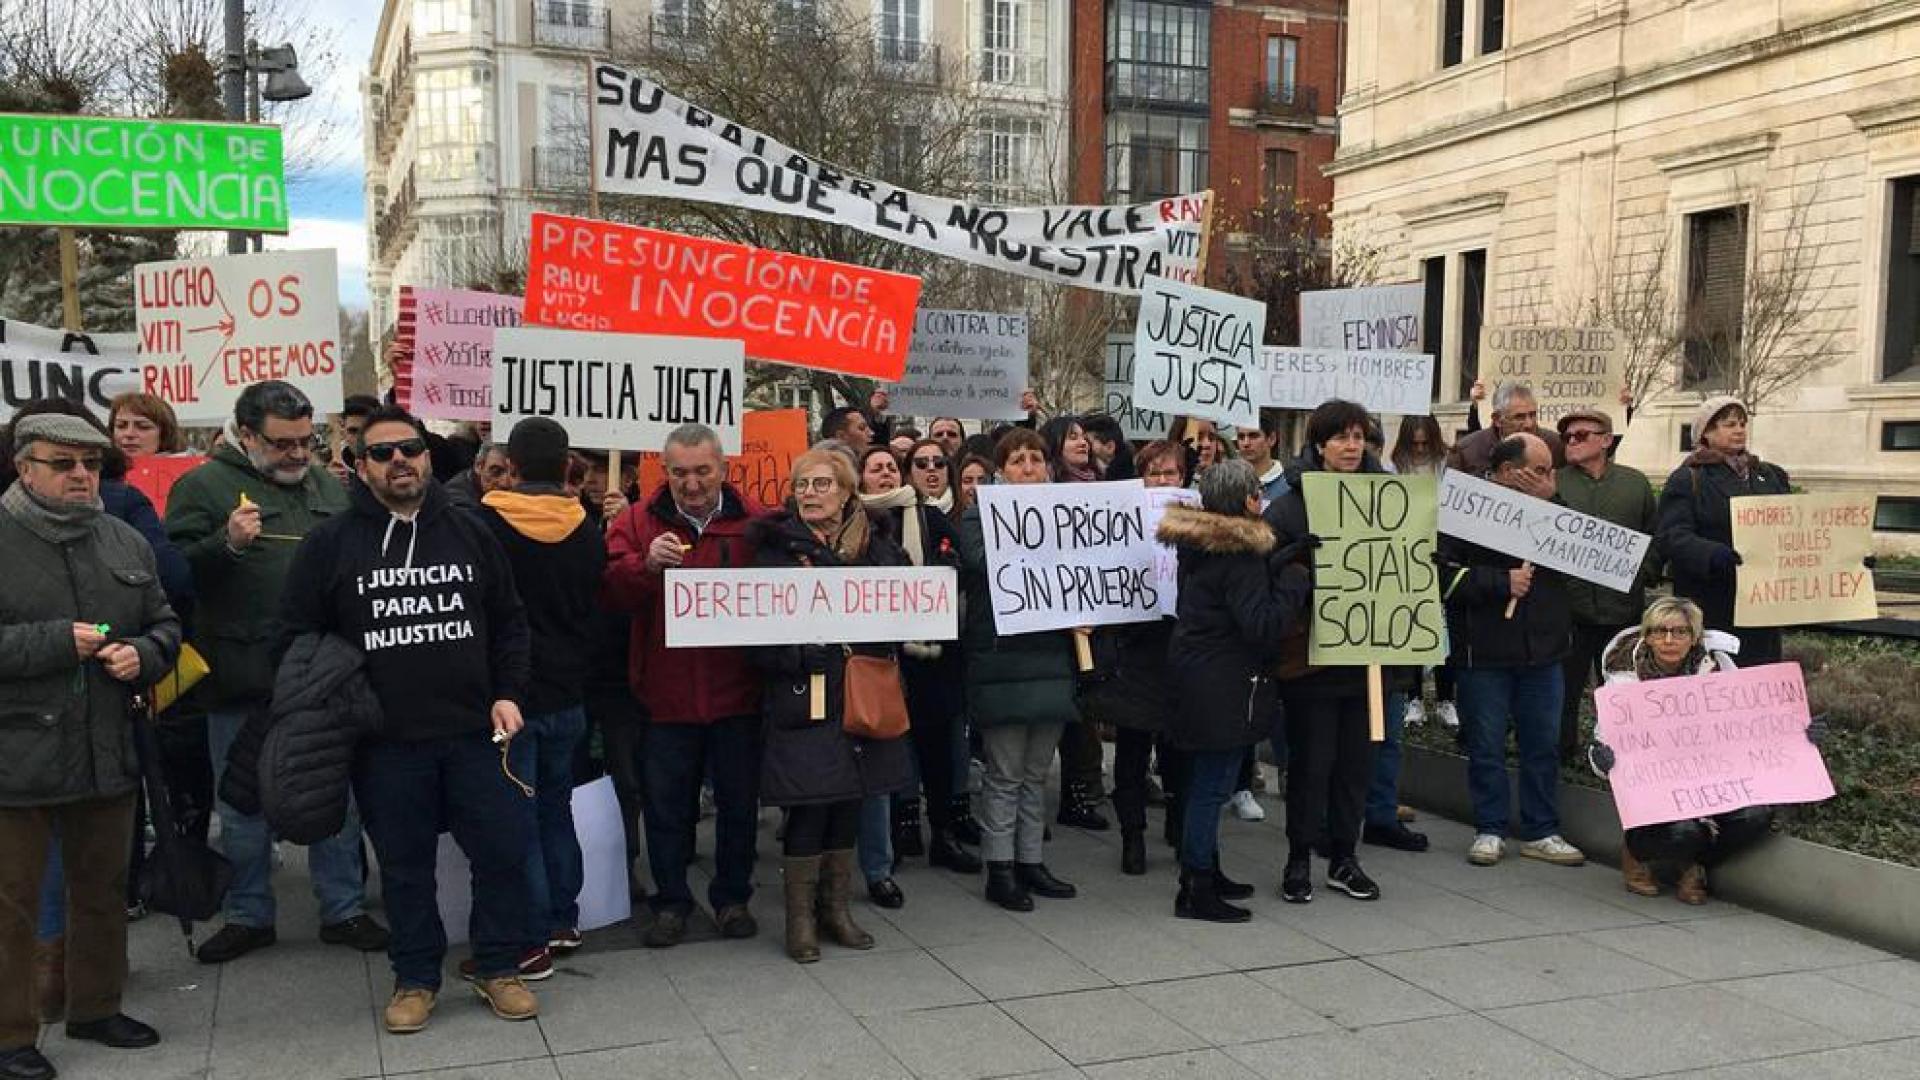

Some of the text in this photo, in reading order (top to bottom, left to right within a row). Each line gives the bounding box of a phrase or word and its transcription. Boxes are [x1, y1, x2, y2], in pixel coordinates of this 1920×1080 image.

[0, 124, 268, 163] UNCIÓN DE
[596, 65, 664, 113] SU
[947, 205, 1008, 236] NO
[1043, 206, 1155, 240] VALE
[605, 127, 708, 186] MAS
[736, 156, 836, 214] QUE
[970, 232, 1161, 289] NUESTRA
[543, 223, 873, 303] PRESUNCIÓN DE
[544, 263, 603, 295] RAUL
[140, 266, 215, 308] LUCHO
[248, 275, 301, 317] OS
[540, 306, 611, 330] LUCHO
[631, 275, 897, 353] INOCENCIA
[925, 312, 989, 334] CONTRA
[1147, 291, 1255, 365] JUSTICIA
[141, 320, 182, 353] VITI
[223, 341, 335, 384] CREEMOS
[1152, 352, 1252, 415] JUSTA
[1347, 356, 1427, 381] HOMBRES
[1499, 354, 1532, 376] QUE
[500, 357, 734, 425] JUSTICIA JUSTA
[990, 499, 1044, 550] NO
[1339, 480, 1409, 532] NO
[1440, 484, 1524, 529] JUSTICIA
[1555, 512, 1641, 554] COBARDE
[1538, 536, 1639, 578] MANIPULADA
[372, 592, 465, 619] PARA LA
[674, 579, 949, 619] DERECHO A DEFENSA
[996, 558, 1052, 616] SIN
[1057, 563, 1158, 612] PRUEBAS
[1750, 572, 1865, 604] ANTE LA LEY
[364, 620, 474, 651] INJUSTICIA
[1318, 596, 1440, 652] SOLOS
[1643, 688, 1698, 720] SOLO
[1702, 678, 1805, 713] ESCUCHAN
[1672, 776, 1756, 812] FUERTE
